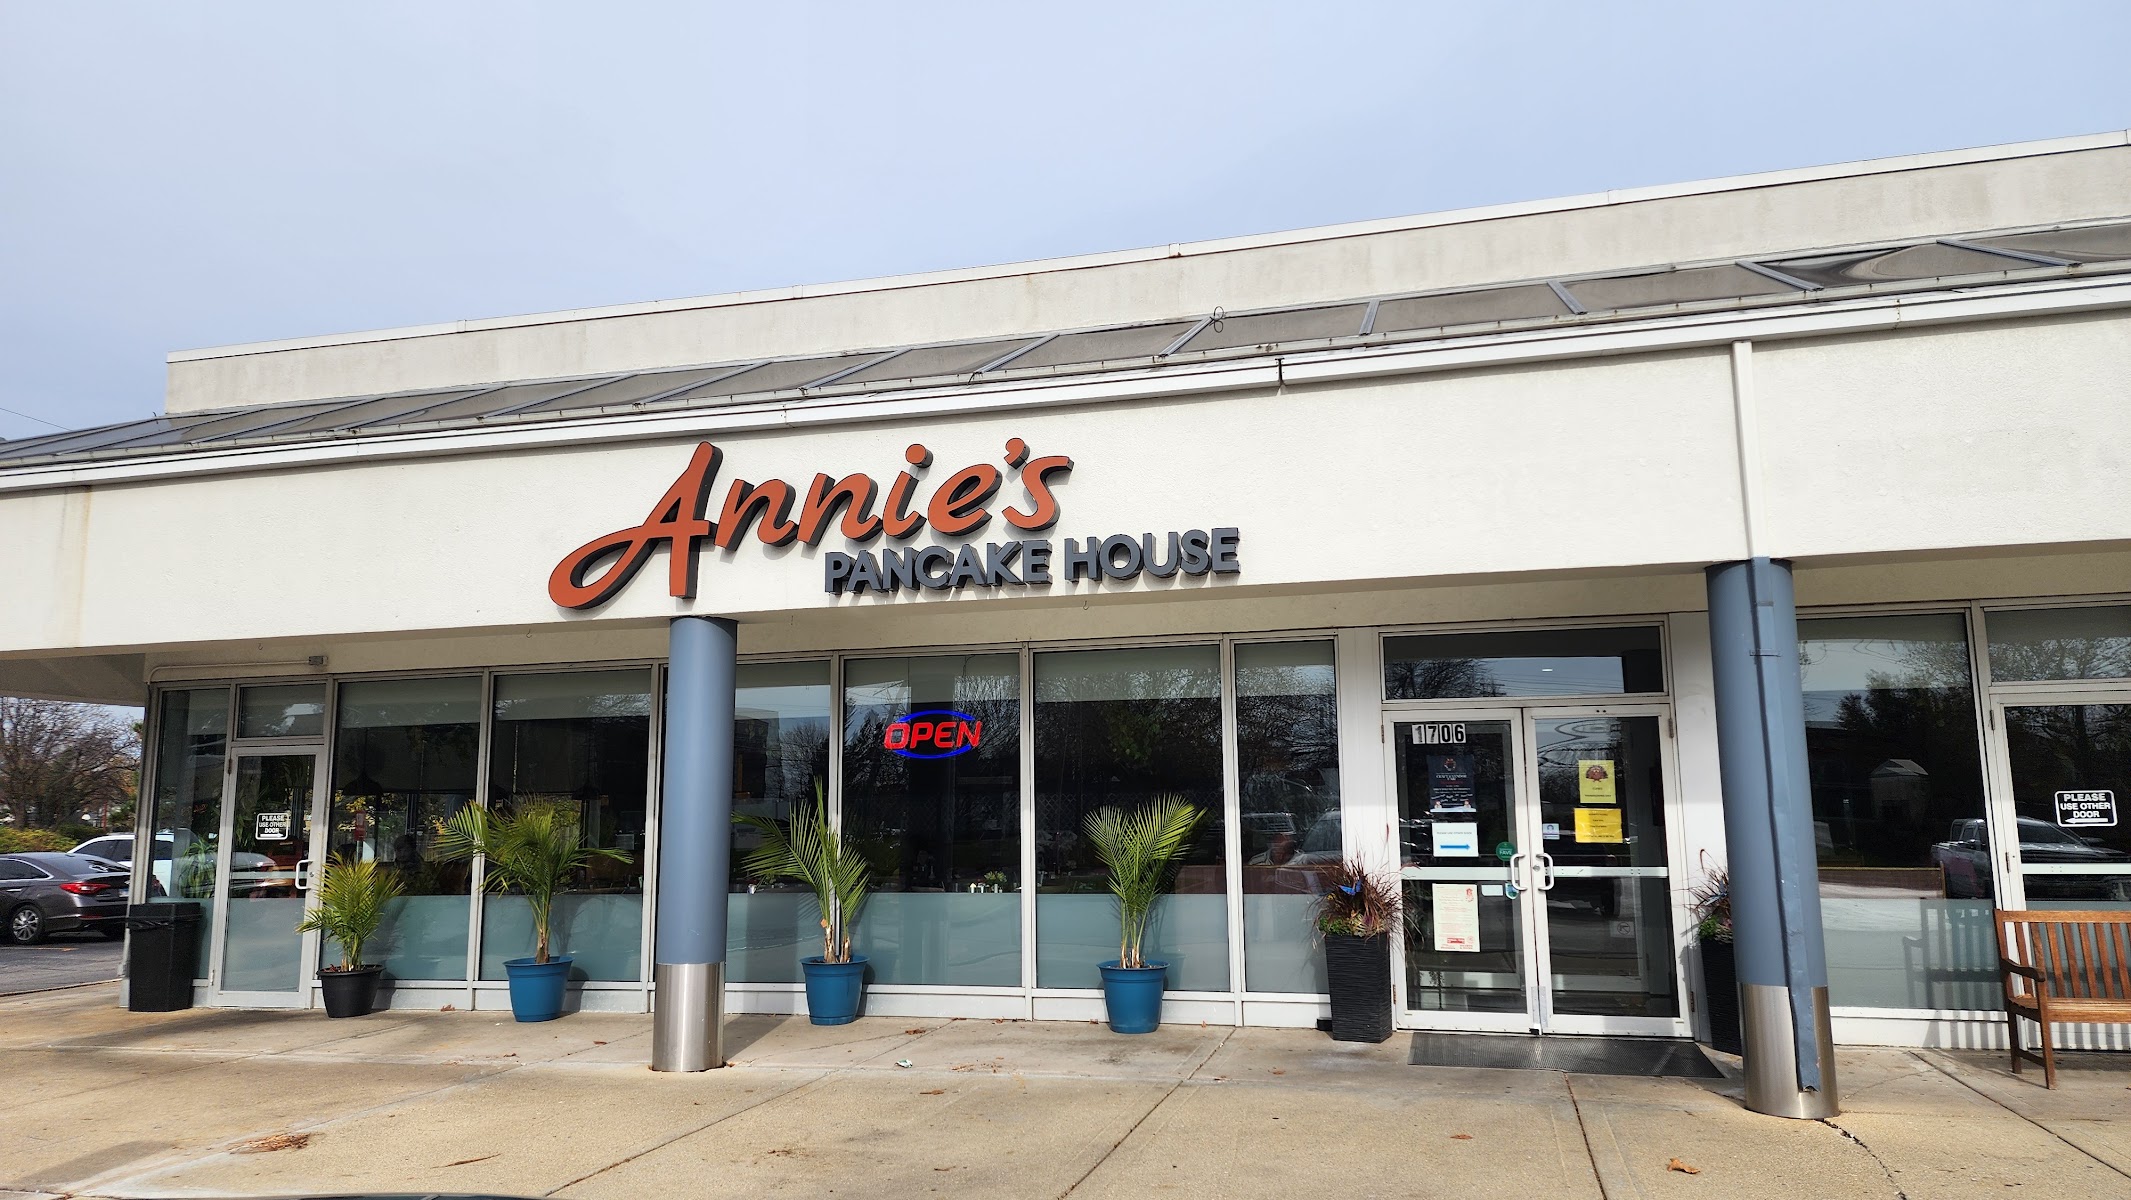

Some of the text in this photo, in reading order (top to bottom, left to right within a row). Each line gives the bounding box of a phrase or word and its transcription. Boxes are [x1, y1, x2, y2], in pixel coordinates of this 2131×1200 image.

[548, 437, 1074, 609] Annie's
[825, 526, 1241, 595] PANCAKE HOUSE
[883, 720, 983, 750] OPEN
[1412, 723, 1466, 744] 1706
[2060, 802, 2111, 810] USE OTHER
[2063, 793, 2106, 801] PLEASE
